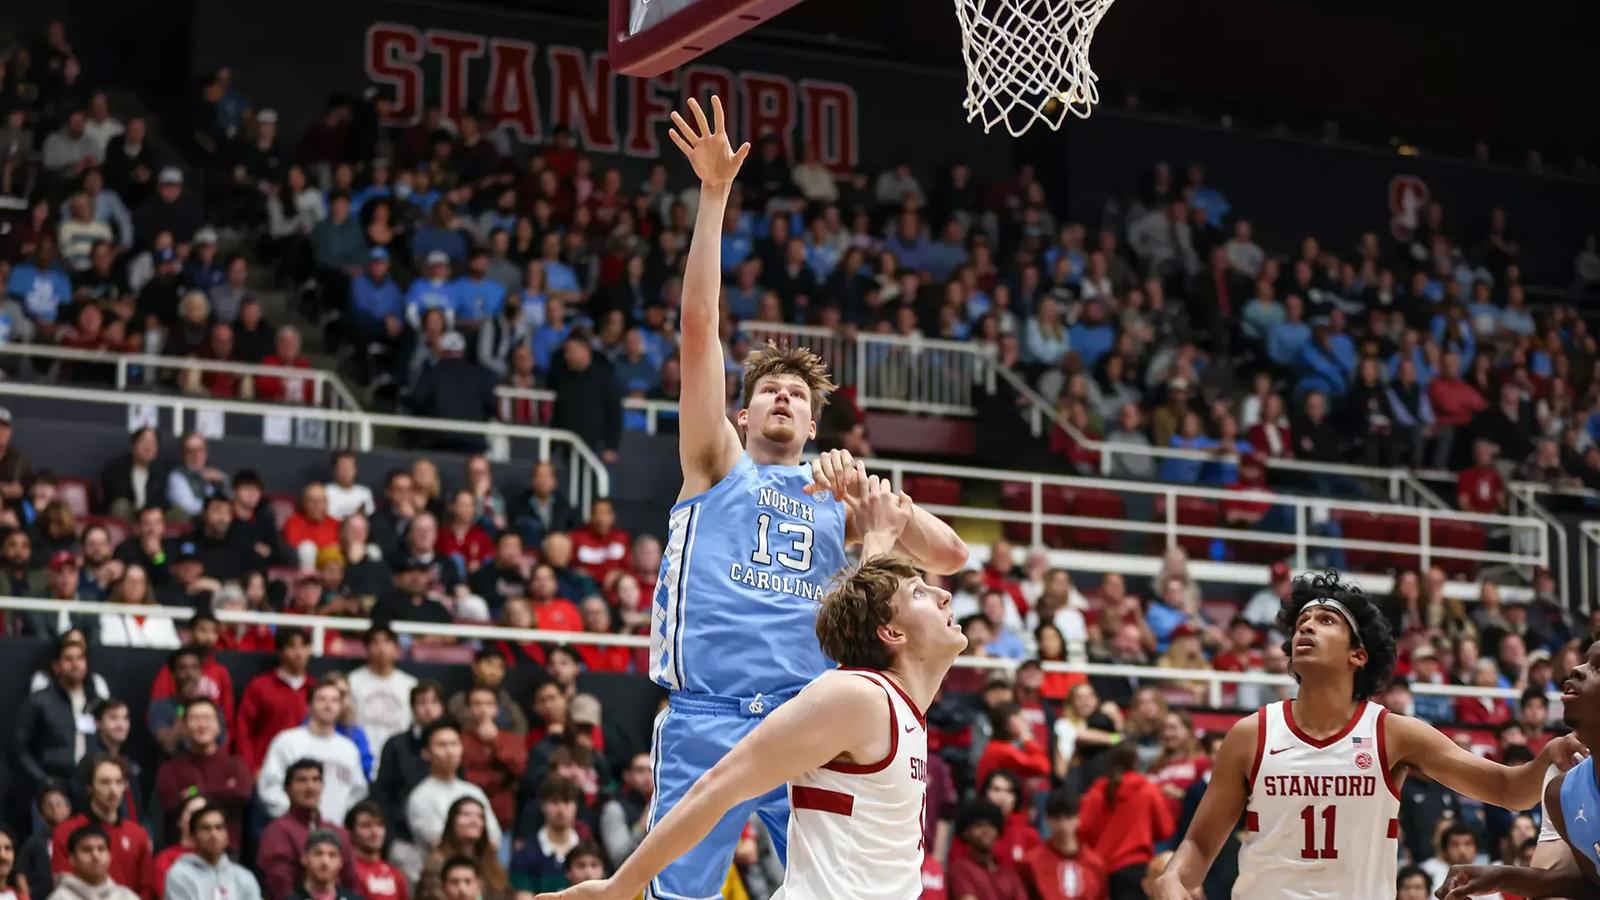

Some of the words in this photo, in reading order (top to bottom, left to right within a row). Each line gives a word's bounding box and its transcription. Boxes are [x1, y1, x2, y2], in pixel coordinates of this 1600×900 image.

[365, 23, 859, 178] STANFORD
[757, 487, 815, 523] NORTH
[751, 513, 815, 572] 13
[730, 562, 824, 600] CAROLINA
[910, 756, 928, 783] STA
[1264, 775, 1376, 796] STANFORD
[1301, 804, 1338, 859] 11
